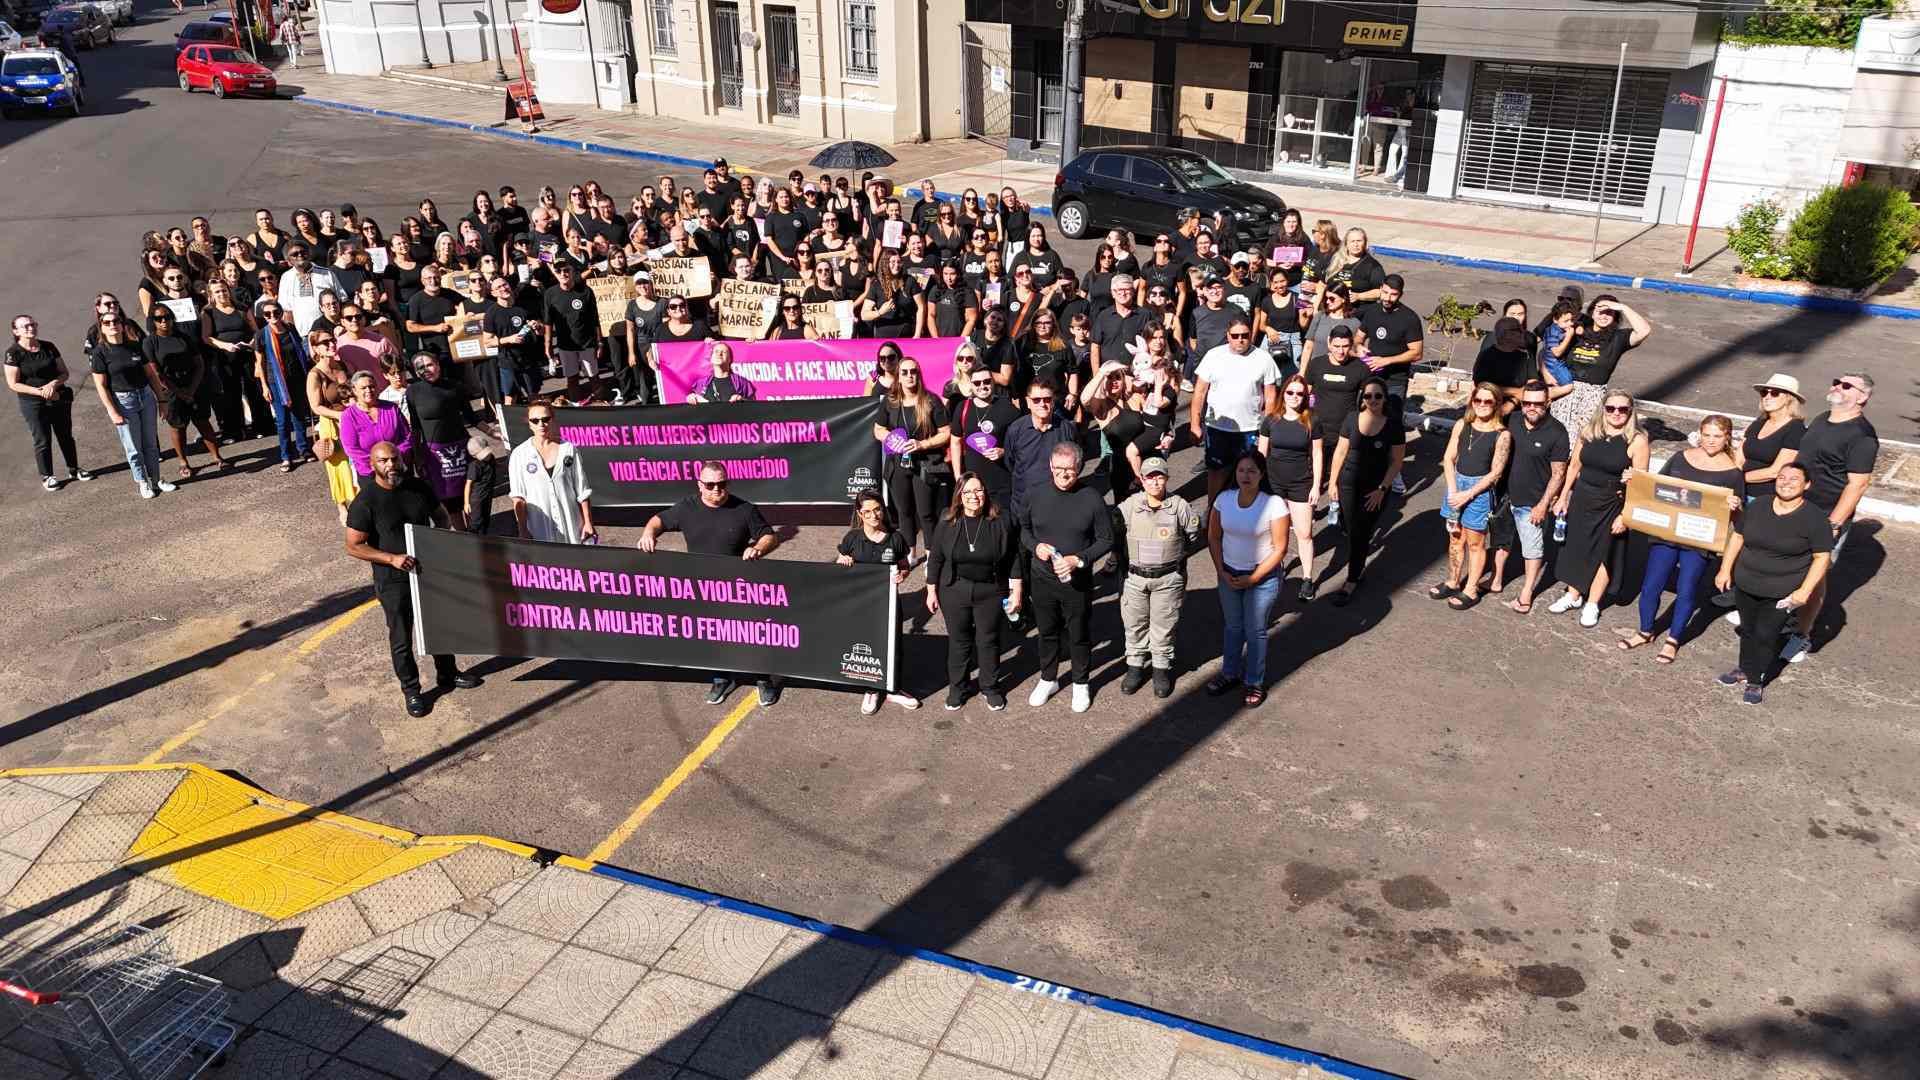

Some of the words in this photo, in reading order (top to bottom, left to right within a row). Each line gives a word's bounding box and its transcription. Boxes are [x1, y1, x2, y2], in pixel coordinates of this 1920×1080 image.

[1349, 27, 1403, 41] PRIME
[652, 258, 694, 270] JOSIANE
[653, 272, 685, 285] PAULA
[785, 361, 795, 381] A
[795, 361, 825, 381] FACE
[826, 360, 856, 381] MAIS
[560, 426, 620, 446] HOMENS
[621, 425, 631, 445] E
[632, 424, 706, 446] MULHERES
[708, 423, 759, 444] UNIDOS
[762, 422, 816, 443] CONTRA
[819, 421, 831, 441] A
[608, 457, 680, 481] VIOLÊNCIA
[682, 461, 692, 480] E
[705, 456, 788, 480] MINICÍDIO
[848, 476, 877, 485] CÂMARA
[510, 563, 586, 592] MARCHA
[589, 571, 632, 596] PELO
[634, 574, 666, 599] FIM
[670, 578, 696, 600] DA
[698, 578, 789, 607] VIOLÊNCIA
[505, 603, 575, 630] CONTRA
[579, 608, 592, 631] A
[593, 609, 664, 637] MULHER
[668, 615, 679, 638] E
[681, 616, 693, 639] O
[697, 618, 800, 648] FEMINICÍDIO
[842, 653, 881, 665] CÂMARA
[841, 662, 884, 676] TAQUARA
[1013, 975, 1072, 1001] 208
